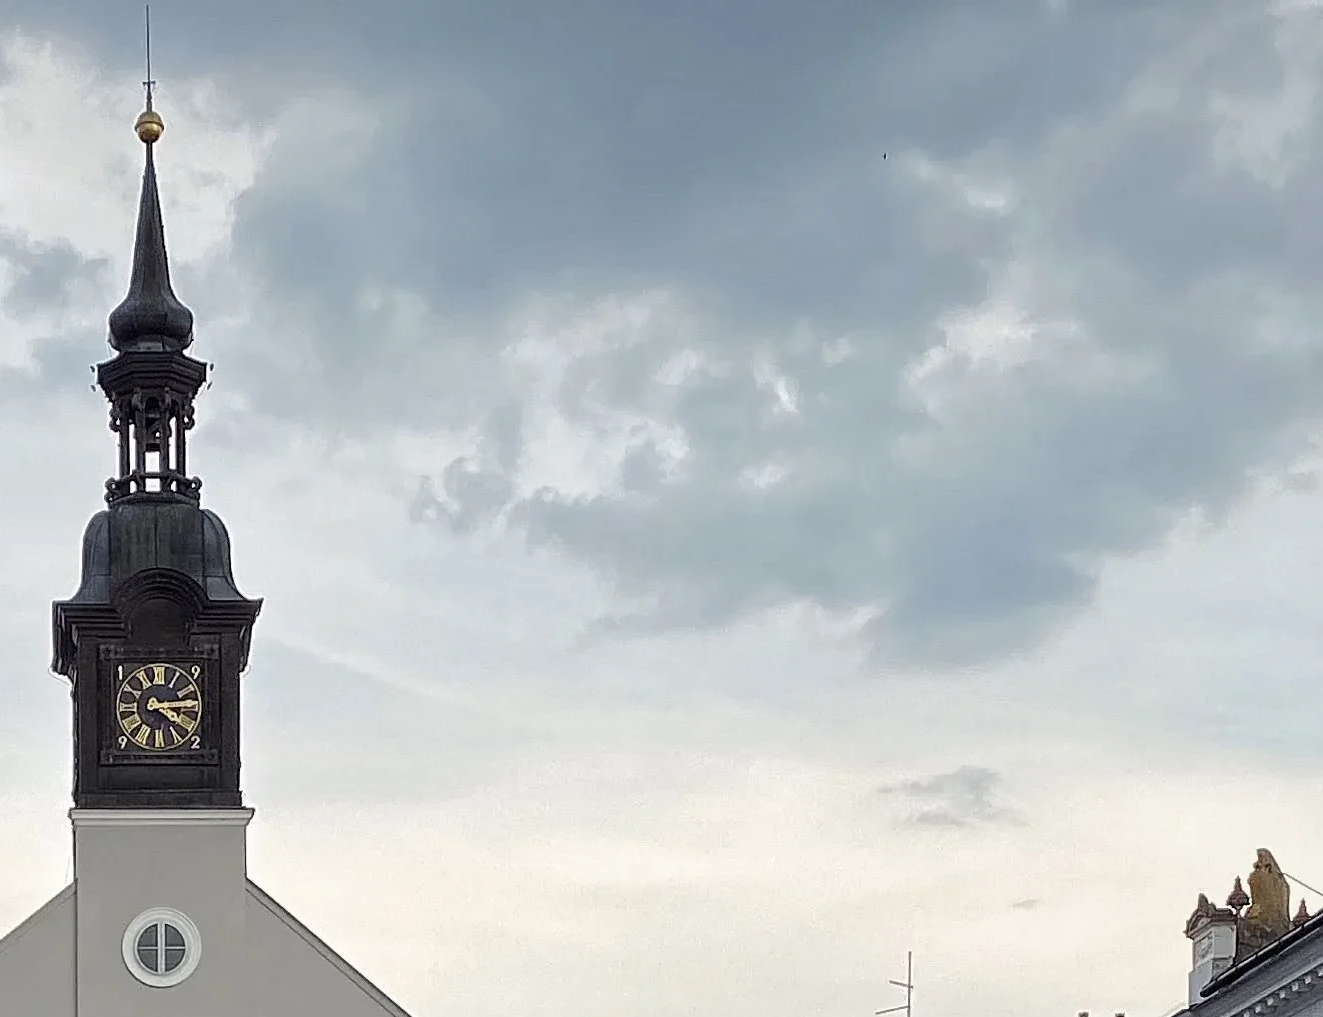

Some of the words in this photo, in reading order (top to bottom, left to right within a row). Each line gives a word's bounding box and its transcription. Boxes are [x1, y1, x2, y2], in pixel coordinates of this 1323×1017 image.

[191, 665, 201, 680] 9
[118, 736, 128, 750] 9
[190, 736, 200, 749] 2
